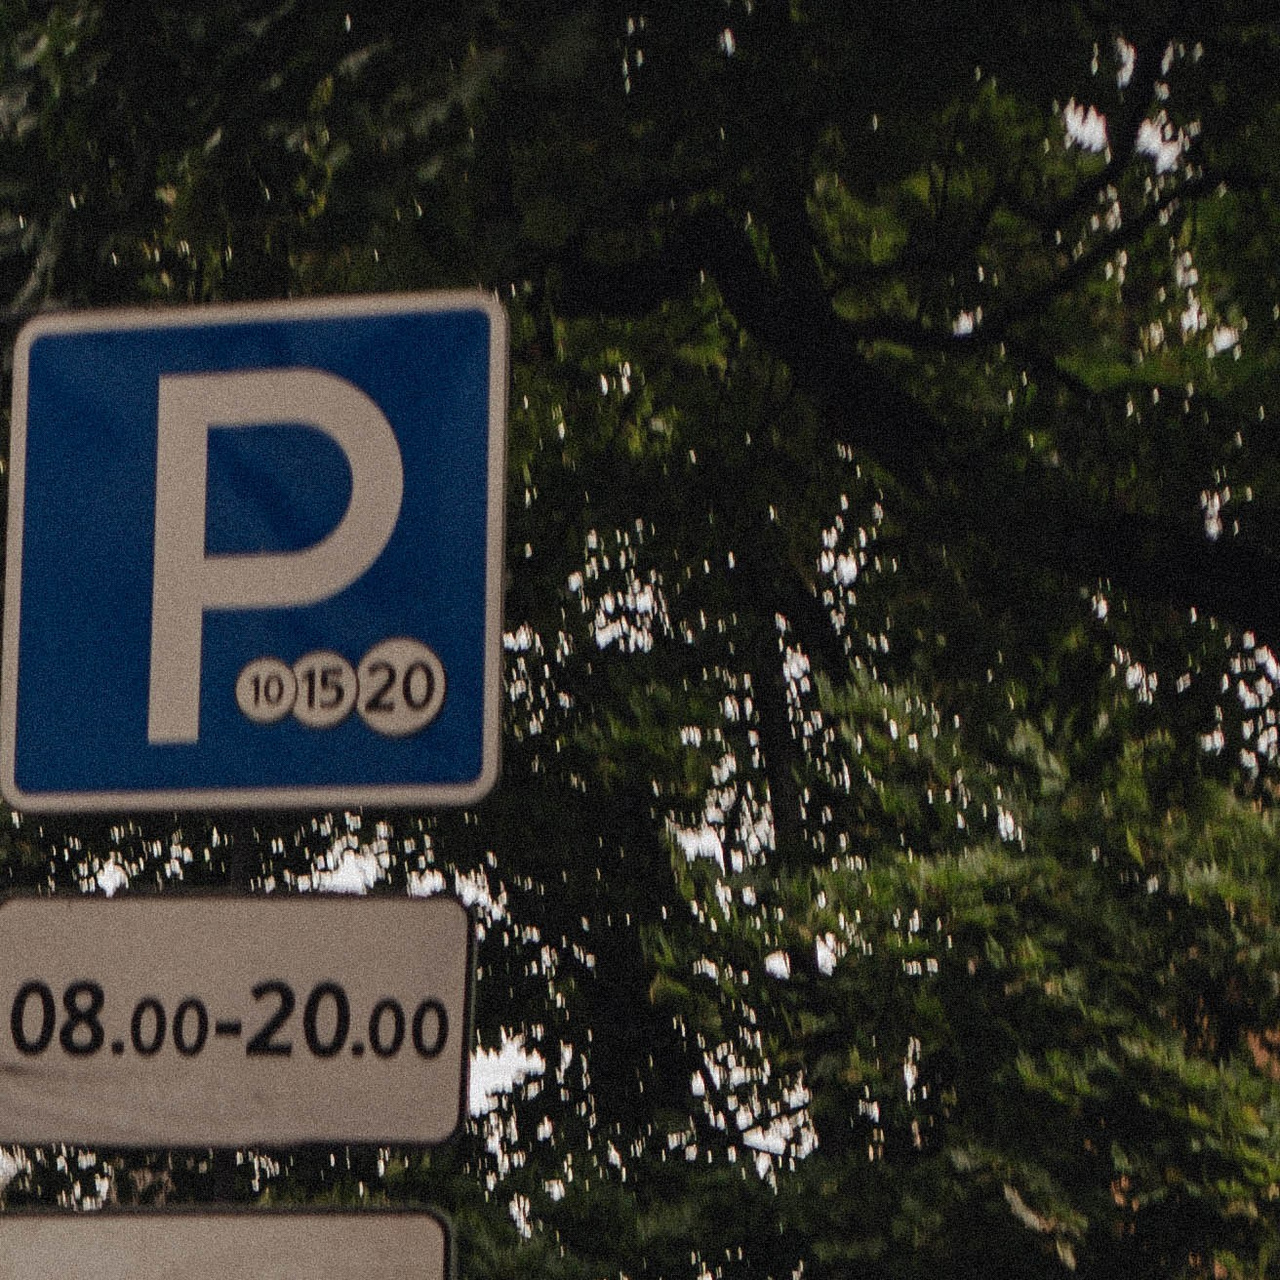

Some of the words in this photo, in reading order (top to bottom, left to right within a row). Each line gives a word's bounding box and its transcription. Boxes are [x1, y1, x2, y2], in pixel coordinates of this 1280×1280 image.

[148, 367, 404, 744] P
[251, 674, 284, 709] 10
[302, 667, 345, 710] 15
[364, 660, 436, 712] 20
[11, 979, 449, 1059] 08.00-20.00
